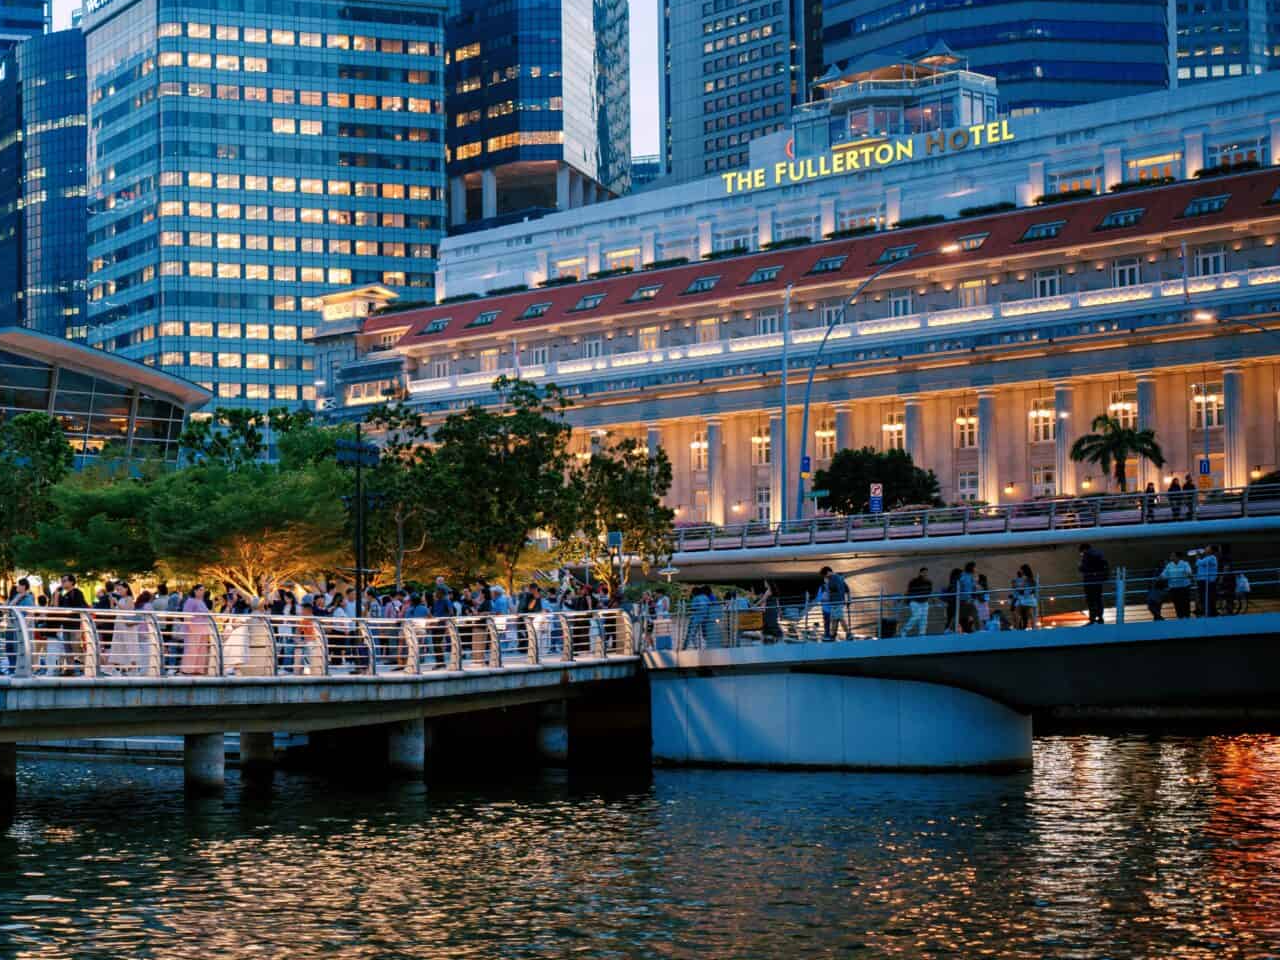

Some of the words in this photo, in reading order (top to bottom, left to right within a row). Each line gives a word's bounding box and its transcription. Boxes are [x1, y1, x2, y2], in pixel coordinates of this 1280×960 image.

[722, 168, 766, 193] THE
[774, 138, 914, 184] FULLERTON
[925, 119, 1015, 154] HOTEL
